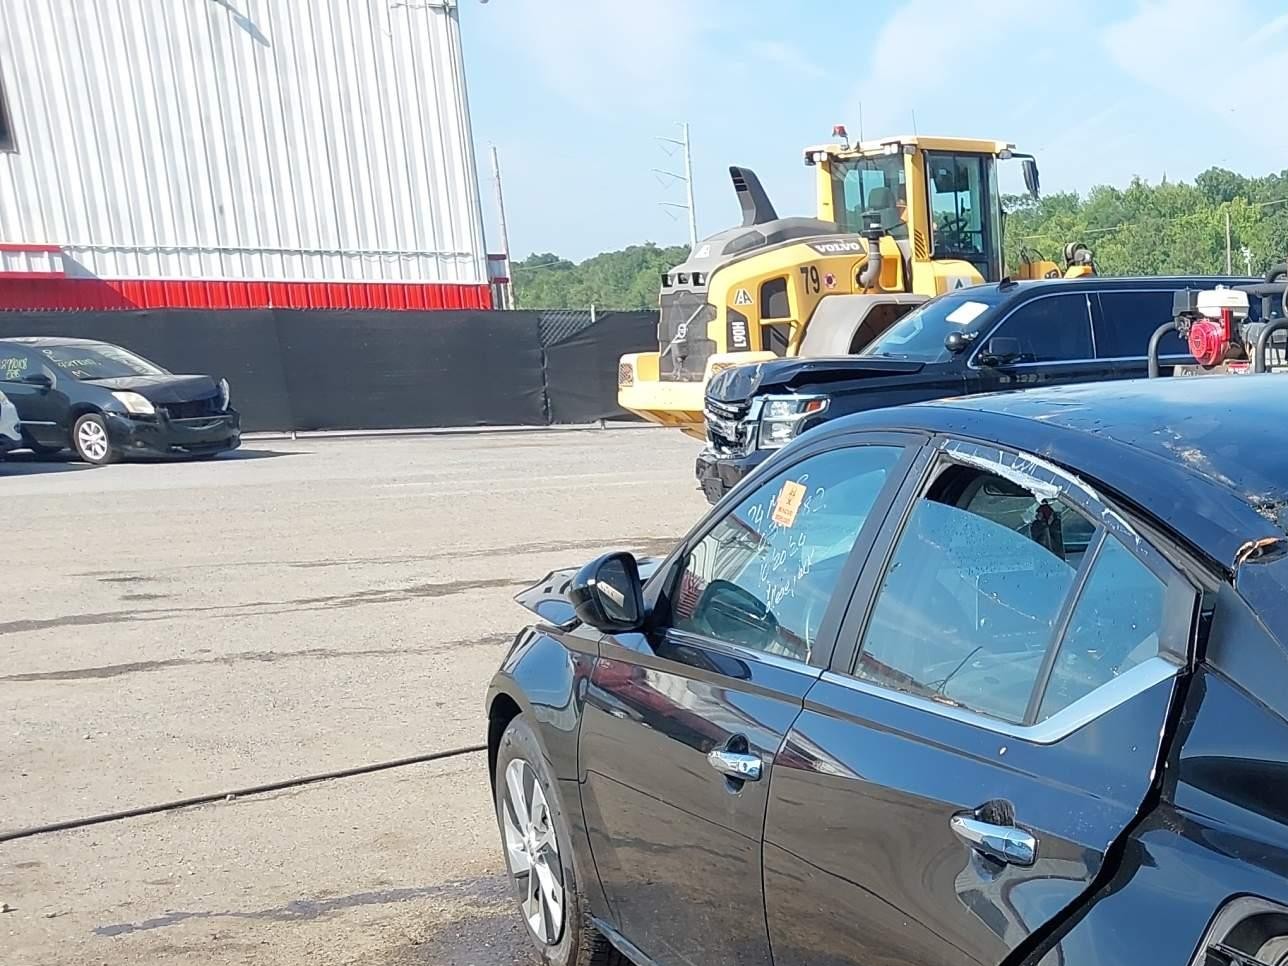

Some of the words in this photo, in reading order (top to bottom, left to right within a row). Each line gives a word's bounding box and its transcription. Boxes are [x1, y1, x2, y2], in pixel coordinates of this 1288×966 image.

[815, 242, 860, 252] VOLVO
[800, 265, 820, 295] 79
[731, 321, 747, 348] L90H
